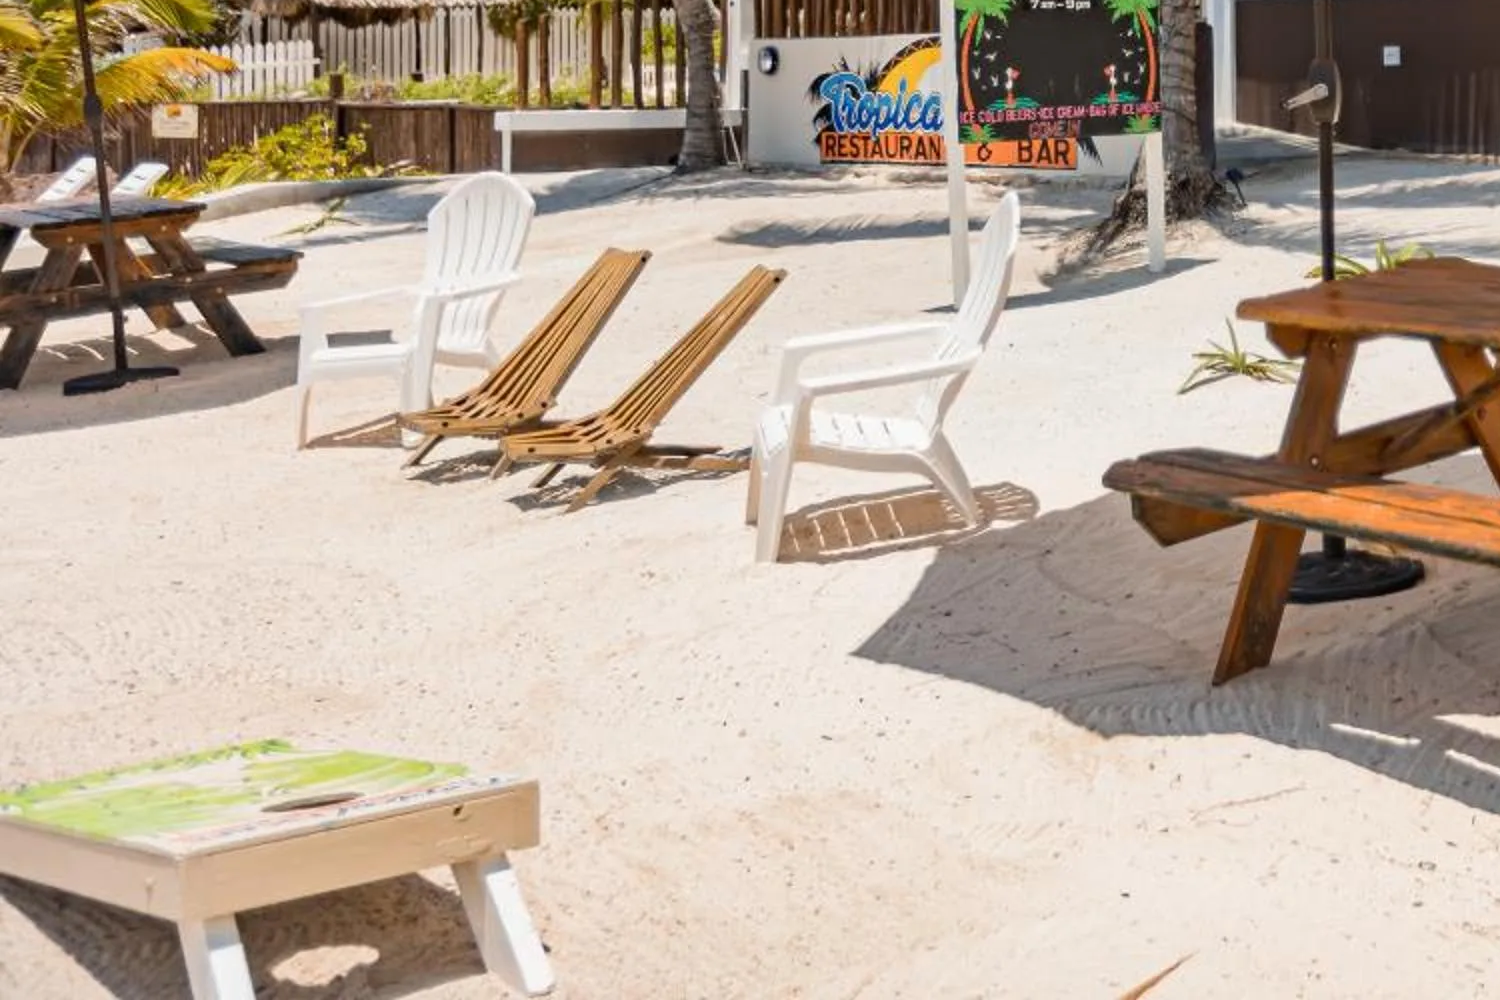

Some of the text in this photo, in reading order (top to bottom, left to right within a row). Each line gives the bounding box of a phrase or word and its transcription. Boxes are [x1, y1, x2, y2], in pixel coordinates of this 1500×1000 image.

[820, 70, 945, 140] Tropica
[959, 110, 976, 124] ICE
[824, 132, 945, 161] RESTAURAN
[1018, 138, 1070, 165] BAR
